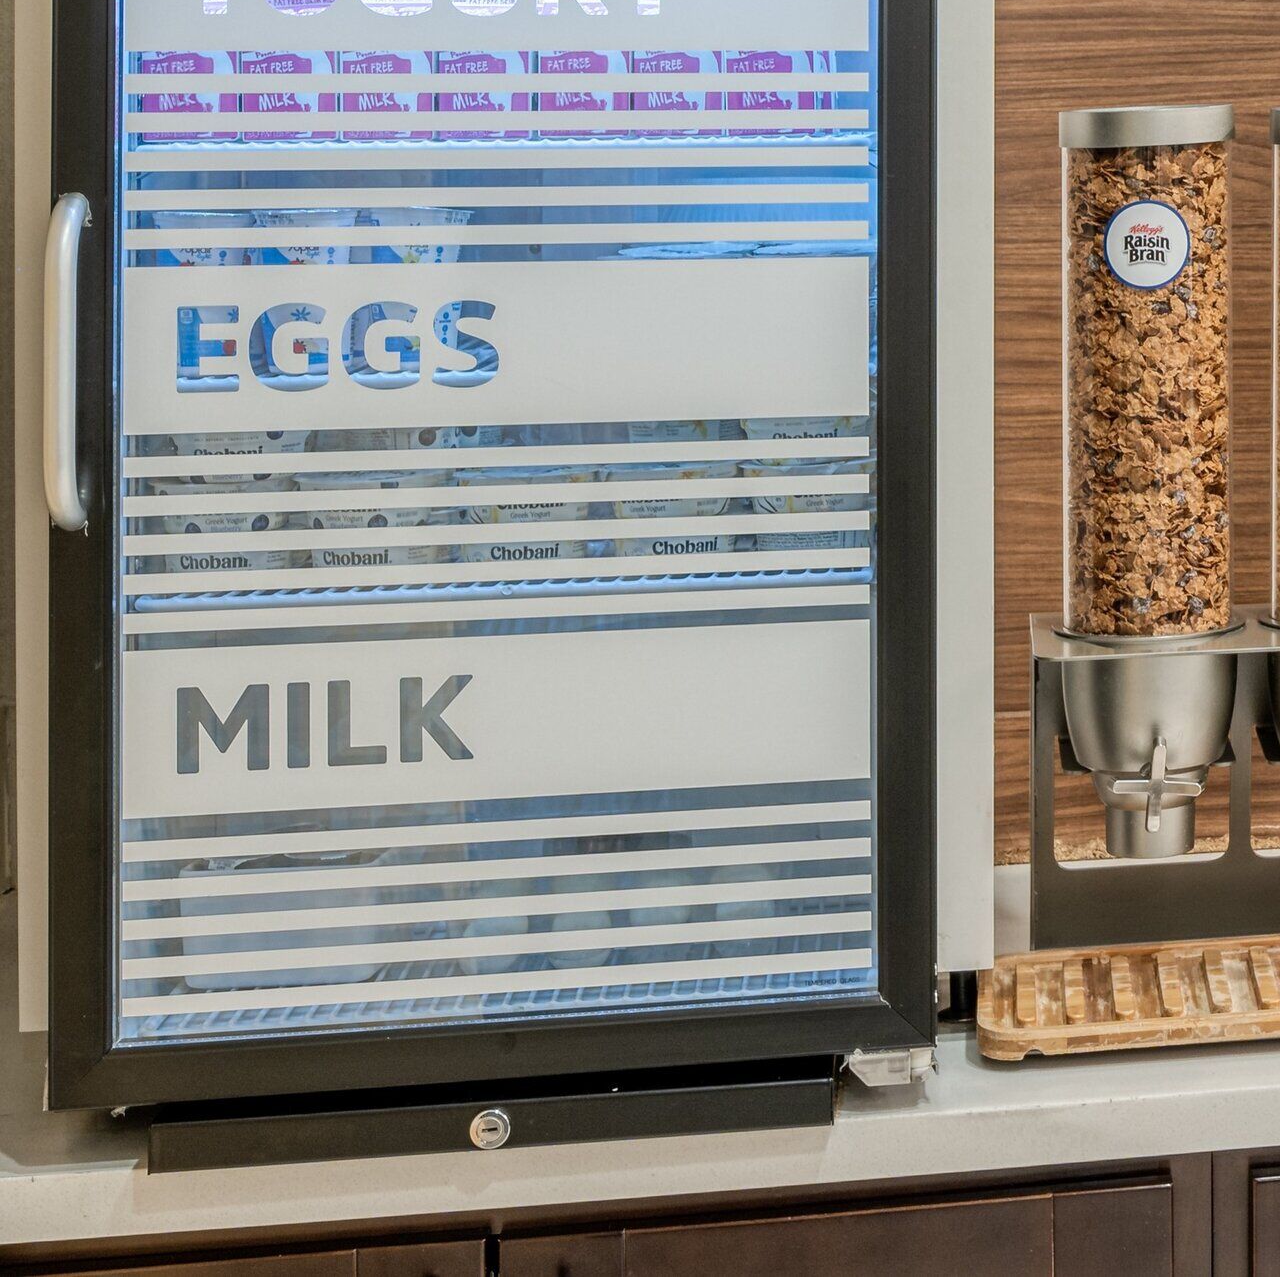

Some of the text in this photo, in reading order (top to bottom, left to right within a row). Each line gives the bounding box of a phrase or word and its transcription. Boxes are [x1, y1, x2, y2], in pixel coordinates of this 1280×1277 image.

[150, 60, 196, 73] FAT FREE
[250, 60, 294, 73] FAT FREE
[350, 61, 394, 73] FAT FREE
[444, 60, 488, 73] FAT FREE
[547, 57, 591, 71] FAT FREE
[639, 59, 683, 72] FAT FREE
[733, 58, 775, 72] FAT FREE
[259, 93, 295, 112] MILK
[358, 93, 394, 111] MILK
[453, 93, 488, 110] MILK
[648, 92, 683, 108] MILK
[1129, 223, 1165, 235] Kellogg's
[1124, 235, 1170, 250] Raisin
[1129, 248, 1166, 262] Bran
[176, 300, 500, 393] EGGS
[176, 673, 475, 774] MILK
